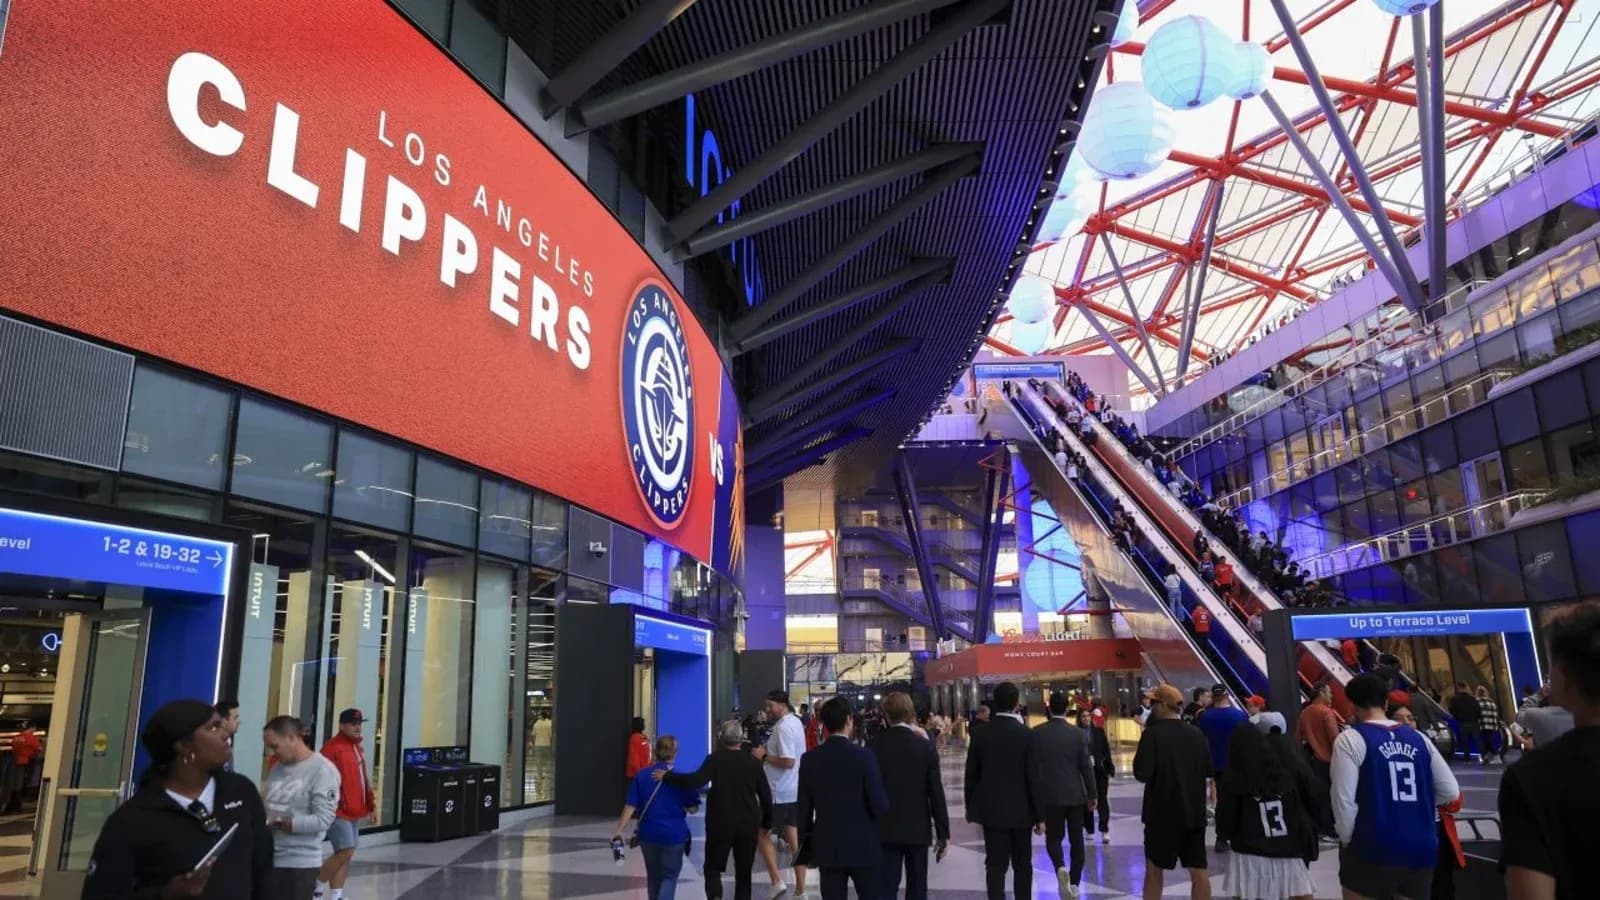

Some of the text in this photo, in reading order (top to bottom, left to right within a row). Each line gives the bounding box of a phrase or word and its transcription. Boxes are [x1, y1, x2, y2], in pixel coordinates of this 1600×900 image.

[167, 52, 591, 370] CLIPPERS
[378, 110, 451, 186] LOS
[473, 185, 594, 298] ANGELES
[628, 293, 692, 400] LOS ANGELES
[632, 443, 689, 516] CLIPPERS
[709, 432, 725, 486] VS
[103, 536, 201, 564] 1-2 & 19-32
[1349, 613, 1470, 629] Up to Terrace Level
[1379, 741, 1418, 760] GEORGE
[1388, 761, 1418, 801] 13
[1259, 800, 1288, 837] 13
